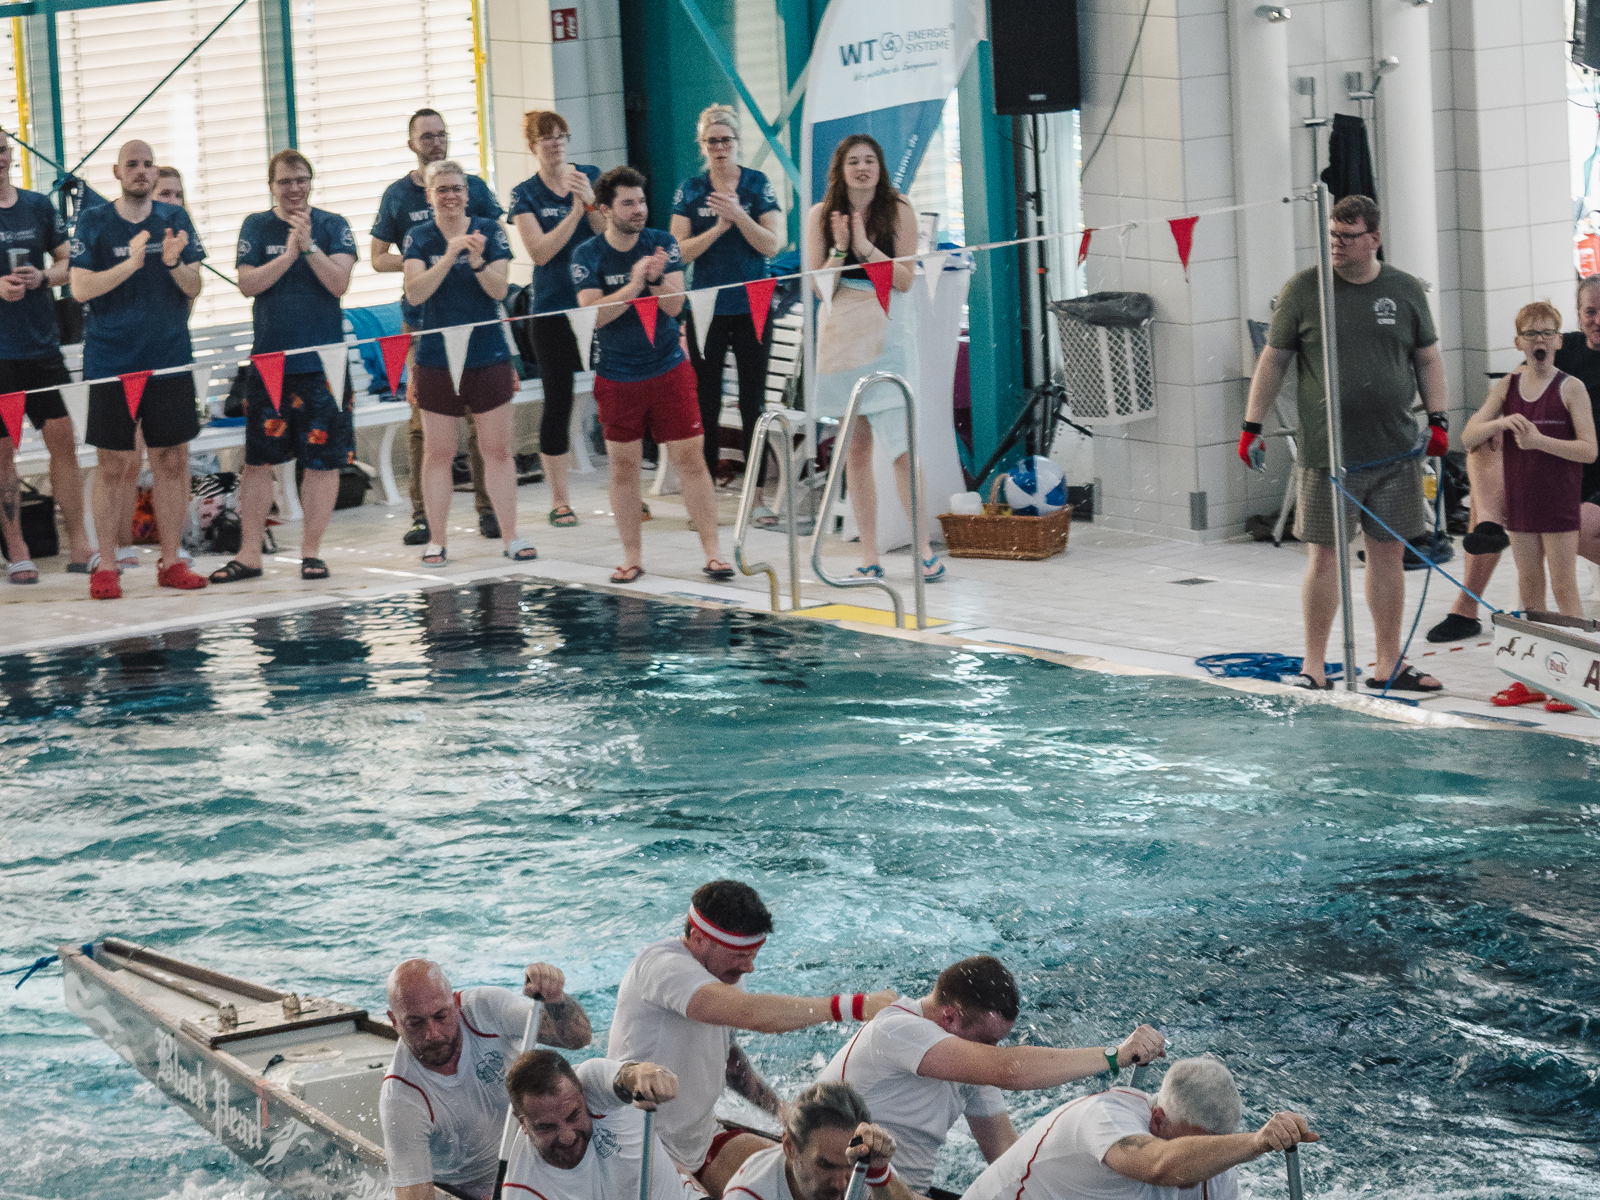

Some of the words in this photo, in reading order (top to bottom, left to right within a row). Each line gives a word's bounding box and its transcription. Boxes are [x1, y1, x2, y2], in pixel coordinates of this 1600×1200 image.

[907, 28, 949, 41] ENERGIE
[840, 39, 878, 67] WT
[905, 40, 950, 54] SYSTEME
[604, 274, 626, 286] WT
[155, 1027, 208, 1114] Black
[210, 1069, 263, 1151] Pearl
